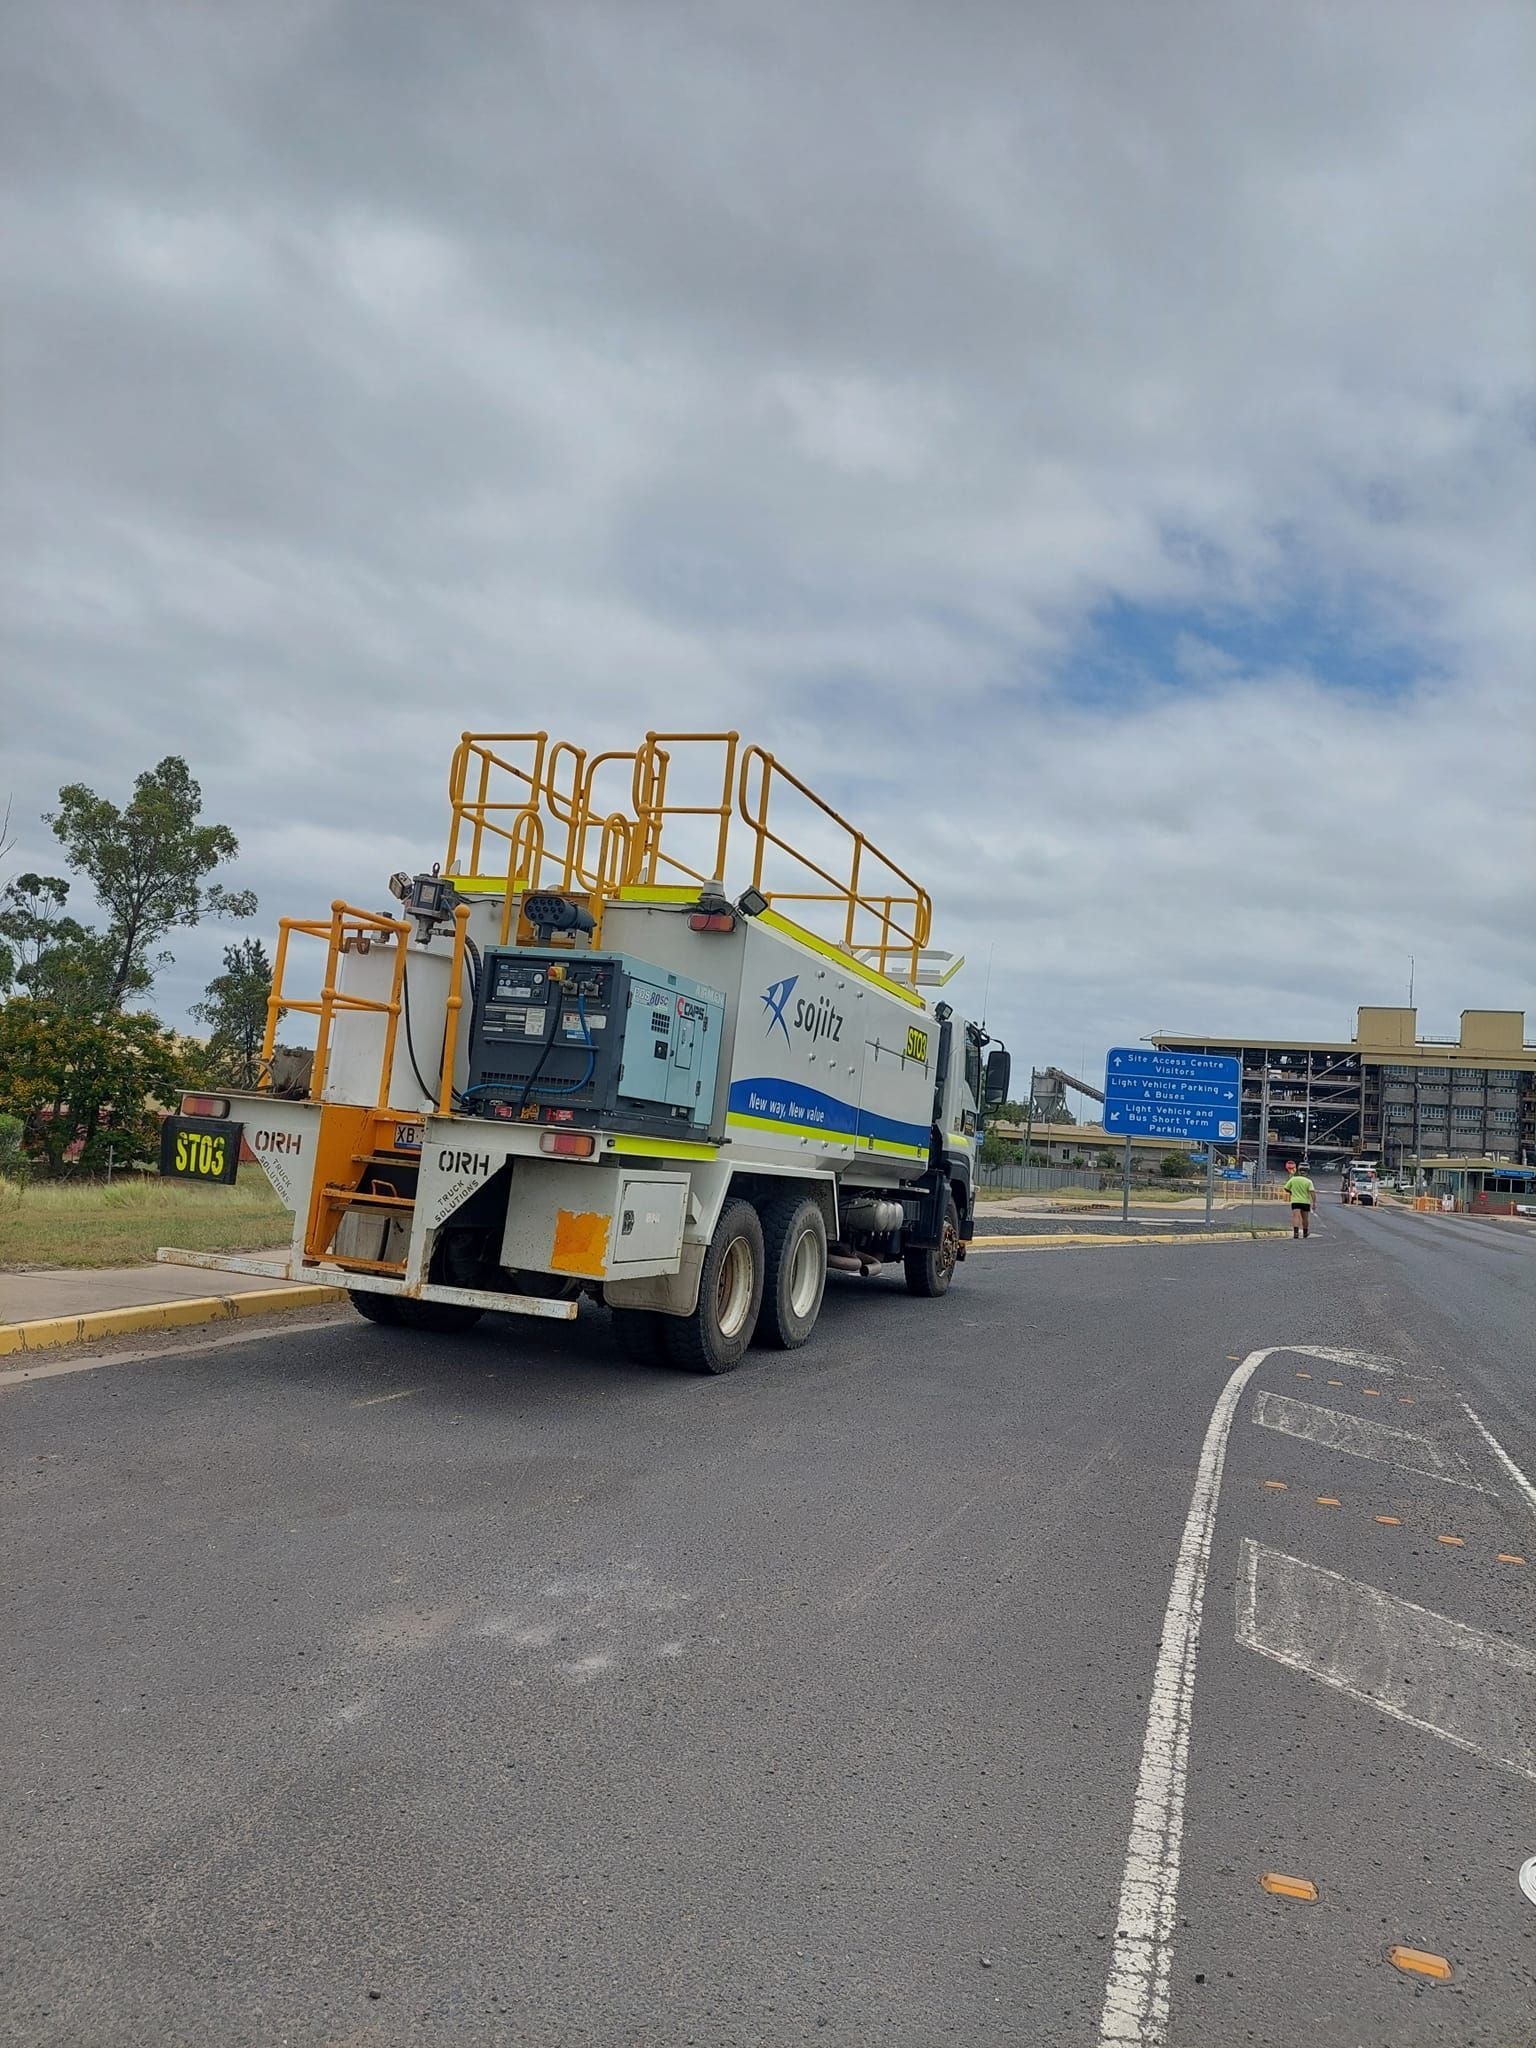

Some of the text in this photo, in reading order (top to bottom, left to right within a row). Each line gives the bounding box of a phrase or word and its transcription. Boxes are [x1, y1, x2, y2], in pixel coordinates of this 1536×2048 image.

[684, 1002, 705, 1020] CAPS
[794, 996, 843, 1043] sojitz
[1128, 1054, 1224, 1069] Site Access Centre
[1155, 1066, 1195, 1076] Visitors
[1111, 1078, 1219, 1094] Light Vehicle Parking
[1155, 1091, 1185, 1100] Buses
[749, 1092, 825, 1123] New way, New value
[1125, 1104, 1214, 1117] Light Vehicle and
[1129, 1113, 1209, 1126] Bus Short Term
[1149, 1124, 1188, 1136] Parking
[255, 1130, 302, 1155] ORH
[272, 1158, 293, 1188] TRUCK
[438, 1150, 490, 1176] ORH
[260, 1155, 291, 1203] SOLUTIONS
[434, 1179, 480, 1223] SOLUTIONS
[437, 1180, 465, 1206] TRUCK
